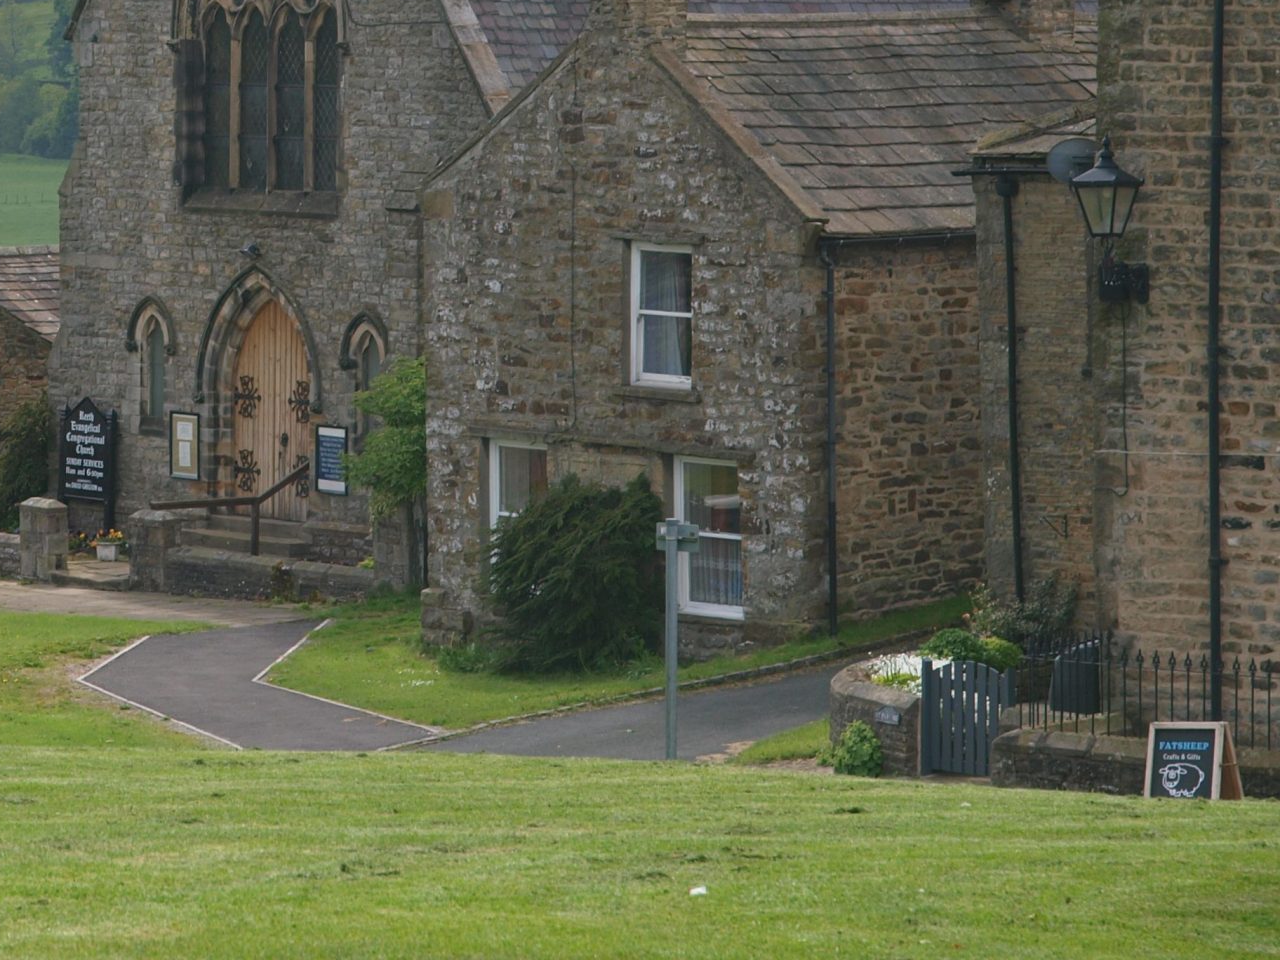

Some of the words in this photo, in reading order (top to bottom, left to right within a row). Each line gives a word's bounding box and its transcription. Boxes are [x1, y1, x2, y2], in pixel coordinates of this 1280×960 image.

[71, 421, 100, 433] Evangelical
[66, 432, 104, 444] Congregational
[76, 444, 94, 456] Church
[66, 457, 81, 466] SUNDAY
[83, 459, 103, 468] SERVICES
[1159, 741, 1209, 750] FATSHEEP
